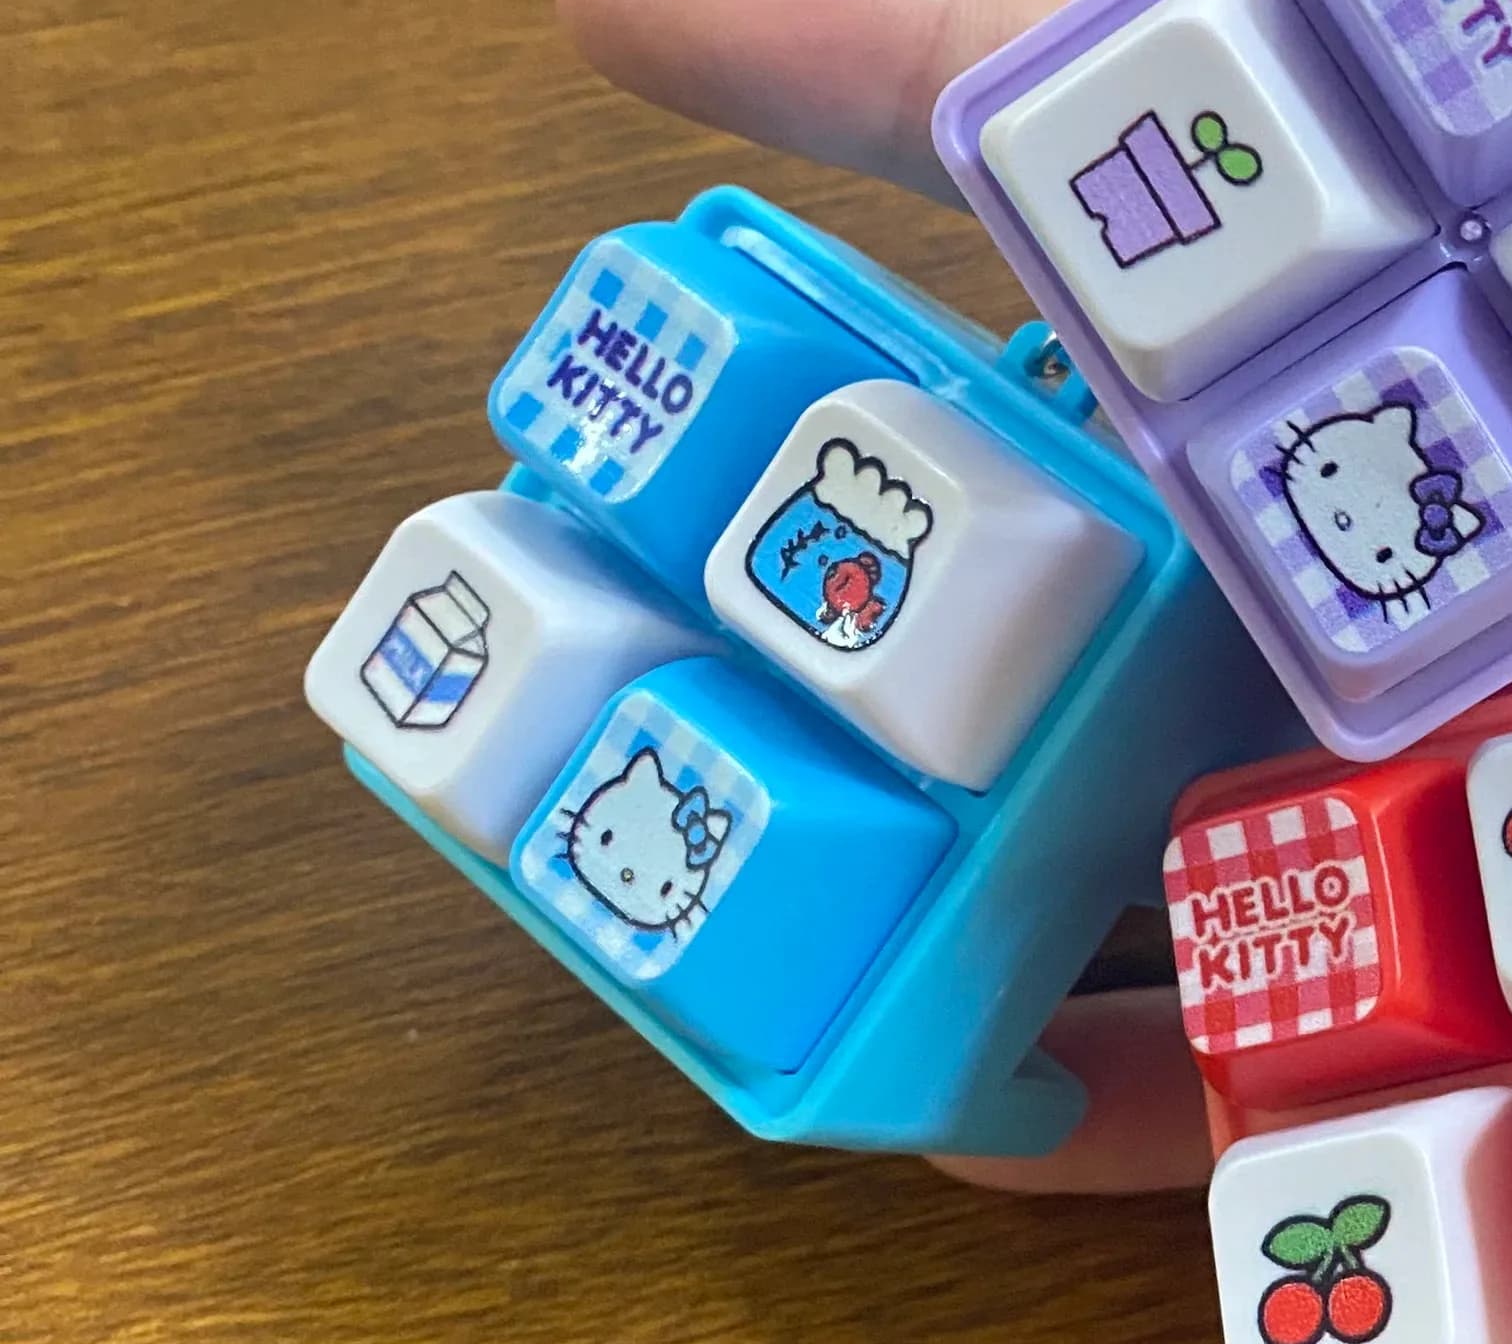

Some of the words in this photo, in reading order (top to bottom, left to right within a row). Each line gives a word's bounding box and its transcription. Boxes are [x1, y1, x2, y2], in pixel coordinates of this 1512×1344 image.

[546, 354, 663, 454] KITTY
[577, 308, 694, 415] HELLO
[1191, 865, 1350, 939] HELLO
[1199, 918, 1350, 989] KITTY
